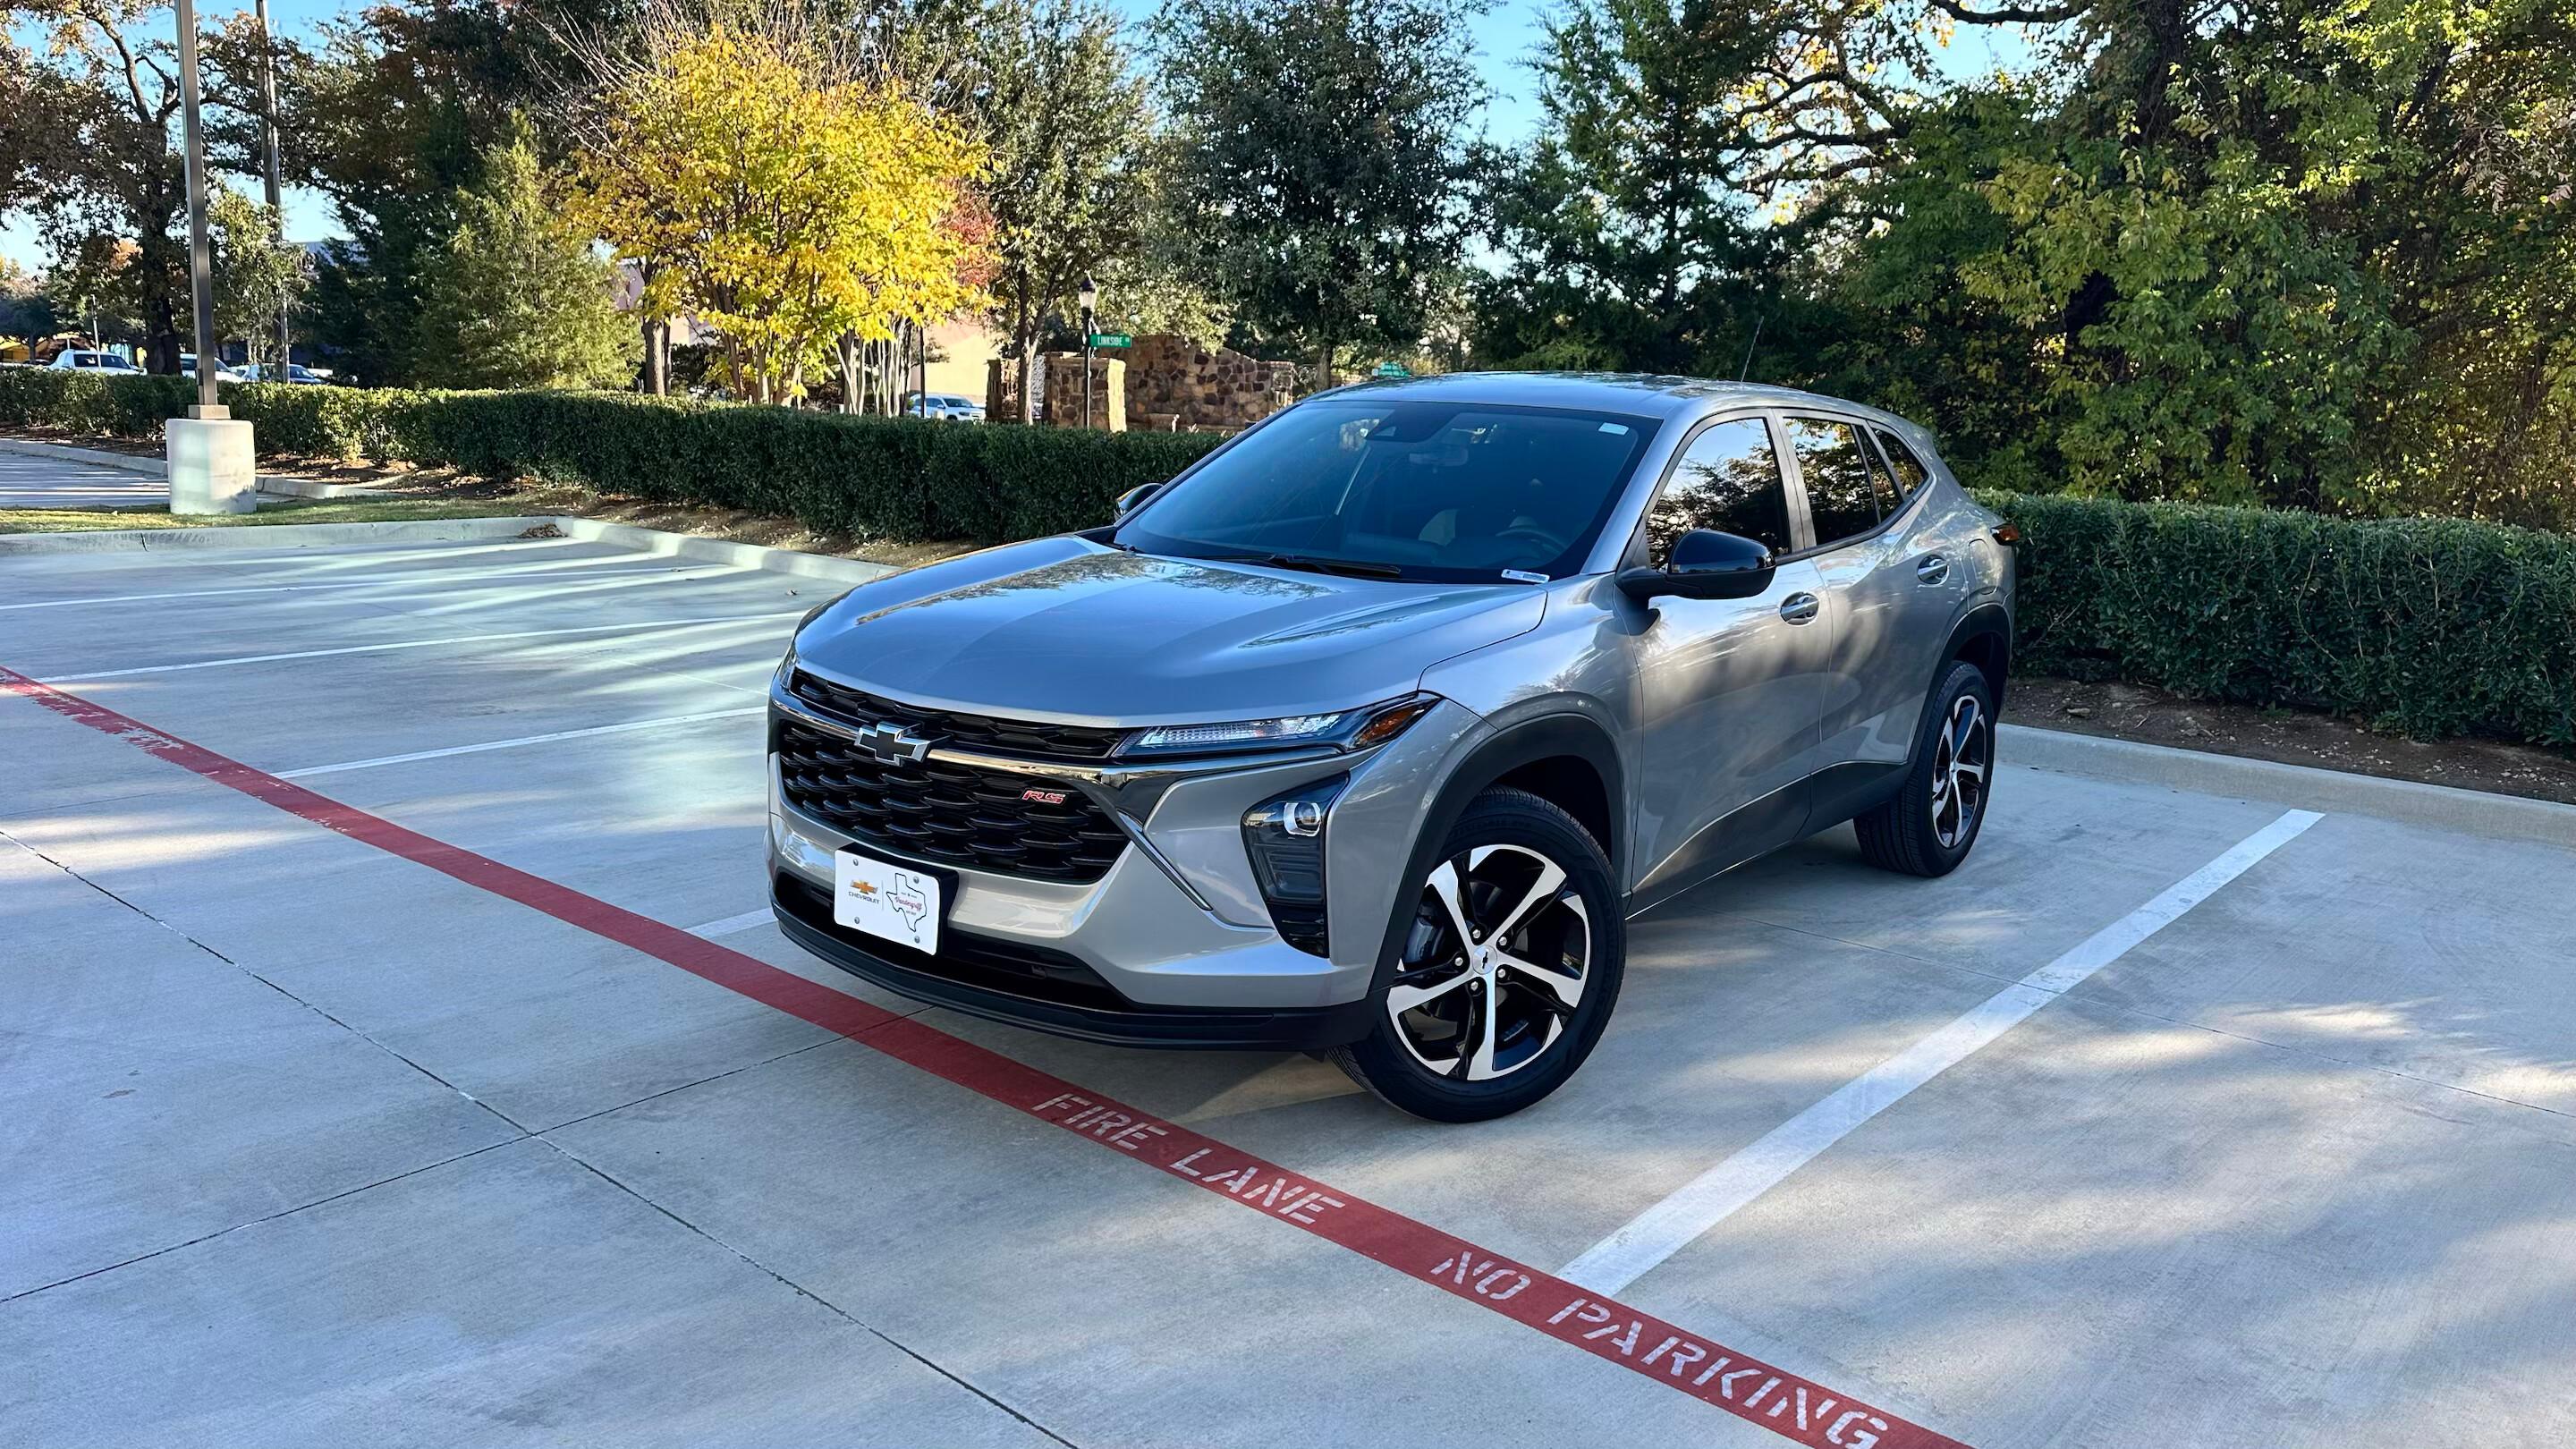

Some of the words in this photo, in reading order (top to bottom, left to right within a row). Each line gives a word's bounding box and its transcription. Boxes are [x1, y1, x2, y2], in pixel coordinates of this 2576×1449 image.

[1021, 790, 1066, 804] RS
[848, 891, 880, 904] CHEVROLET
[1030, 1092, 1169, 1151] FIRE
[1169, 1148, 1347, 1224] LANE
[1430, 1250, 1531, 1301] NO
[1547, 1297, 1889, 1449] PARKING
